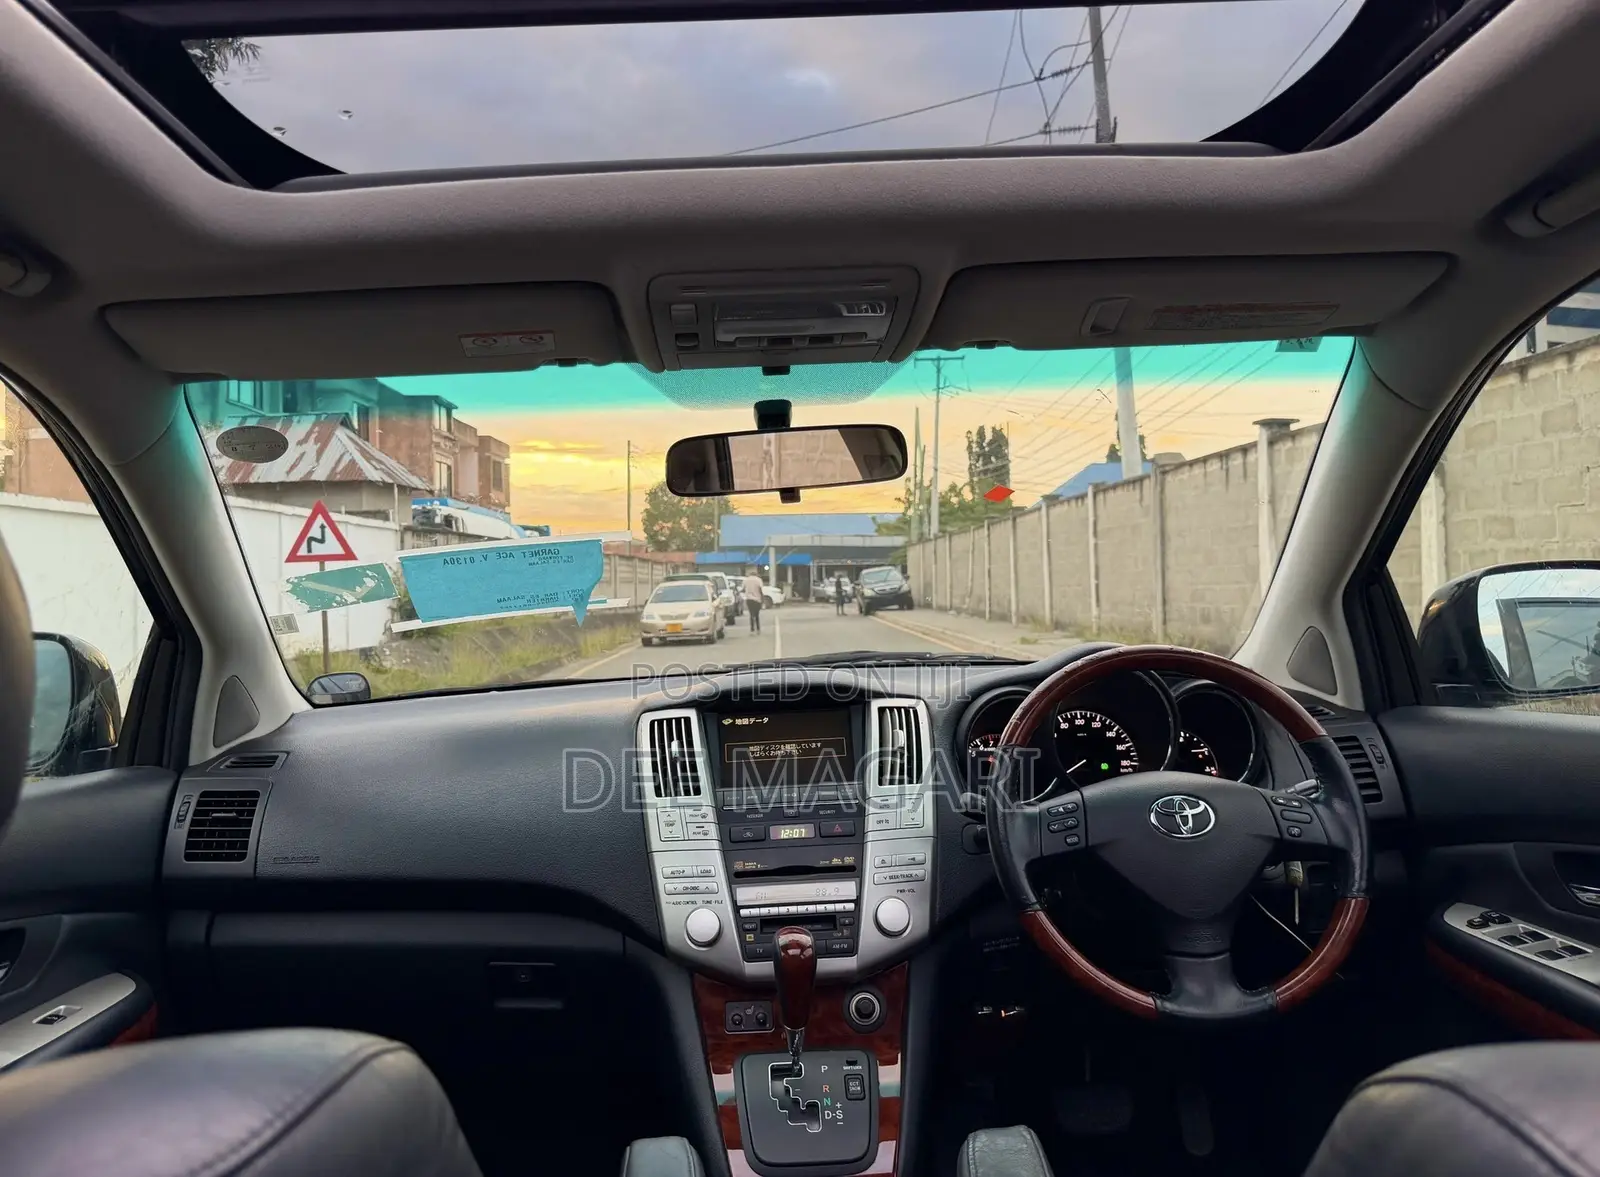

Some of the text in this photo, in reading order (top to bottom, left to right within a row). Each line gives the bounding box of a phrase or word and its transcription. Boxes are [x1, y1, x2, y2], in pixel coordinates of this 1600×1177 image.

[735, 717, 769, 725] 地図データ
[780, 828, 806, 838] 12:07
[821, 1065, 828, 1073] P
[822, 1084, 830, 1093] R
[823, 1097, 831, 1106] N
